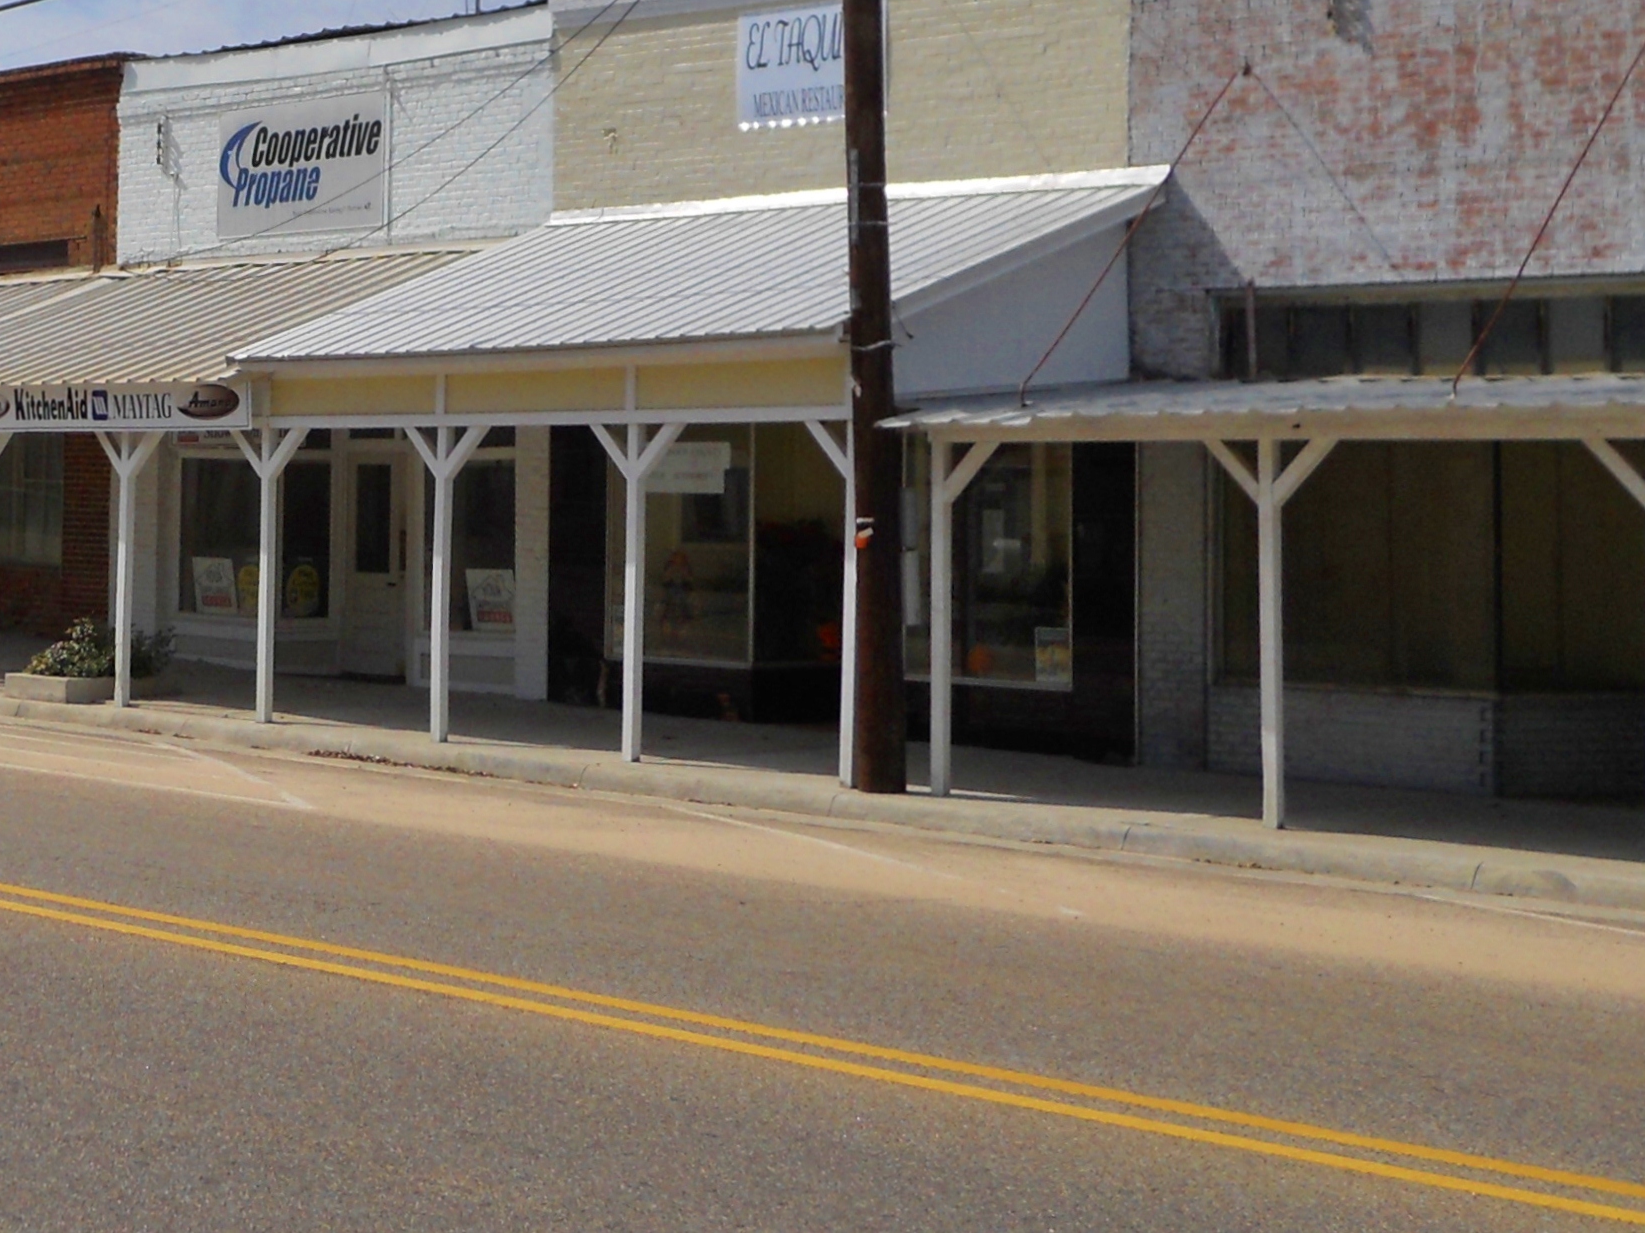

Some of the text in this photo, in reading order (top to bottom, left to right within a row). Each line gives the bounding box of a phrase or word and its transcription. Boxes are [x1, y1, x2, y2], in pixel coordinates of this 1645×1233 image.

[746, 12, 844, 72] EL TAQUI
[753, 84, 845, 117] MEXICAN RESTAUR
[251, 113, 382, 168] Cooperative
[232, 166, 321, 209] Propane
[14, 387, 89, 421] KitchenAid
[113, 393, 172, 420] MAYTAG
[188, 390, 234, 408] Amana
